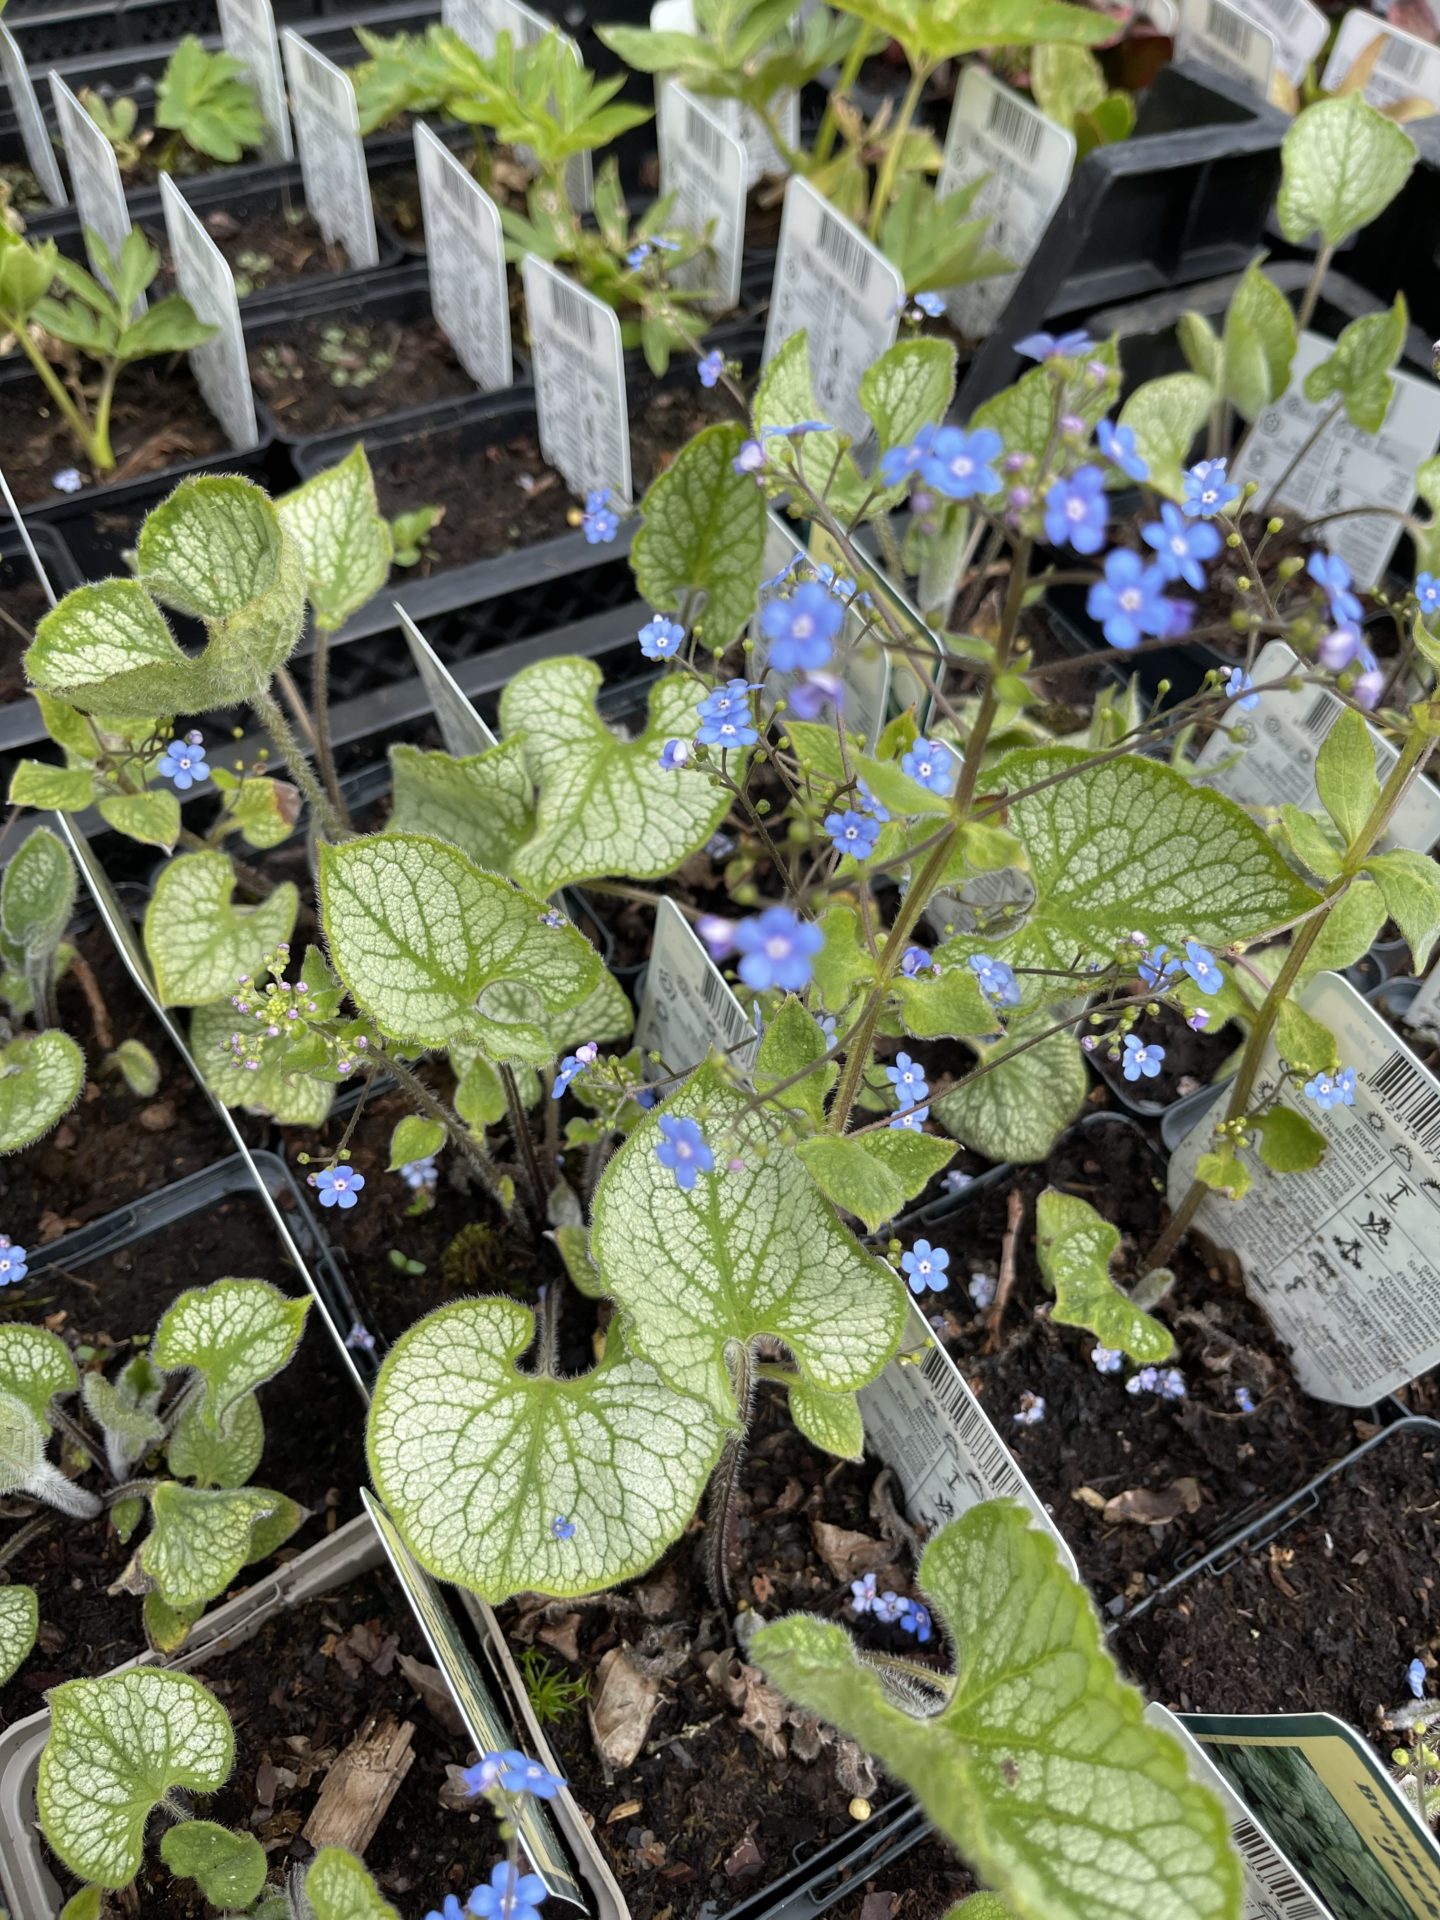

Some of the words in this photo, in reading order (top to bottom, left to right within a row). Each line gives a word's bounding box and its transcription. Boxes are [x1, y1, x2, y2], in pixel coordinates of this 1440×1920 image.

[1357, 1072, 1366, 1082] 8
[1370, 1089, 1419, 1141] 712815
[1321, 1112, 1354, 1151] Blossom
[1354, 1151, 1373, 1171] time
[1322, 1126, 1334, 1139] de
[1333, 1138, 1367, 1177] floraison
[1345, 1127, 1379, 1167] Blütezeit
[1352, 1123, 1385, 1160] Bloeitijd
[1415, 1281, 1440, 1315] Cutflo
